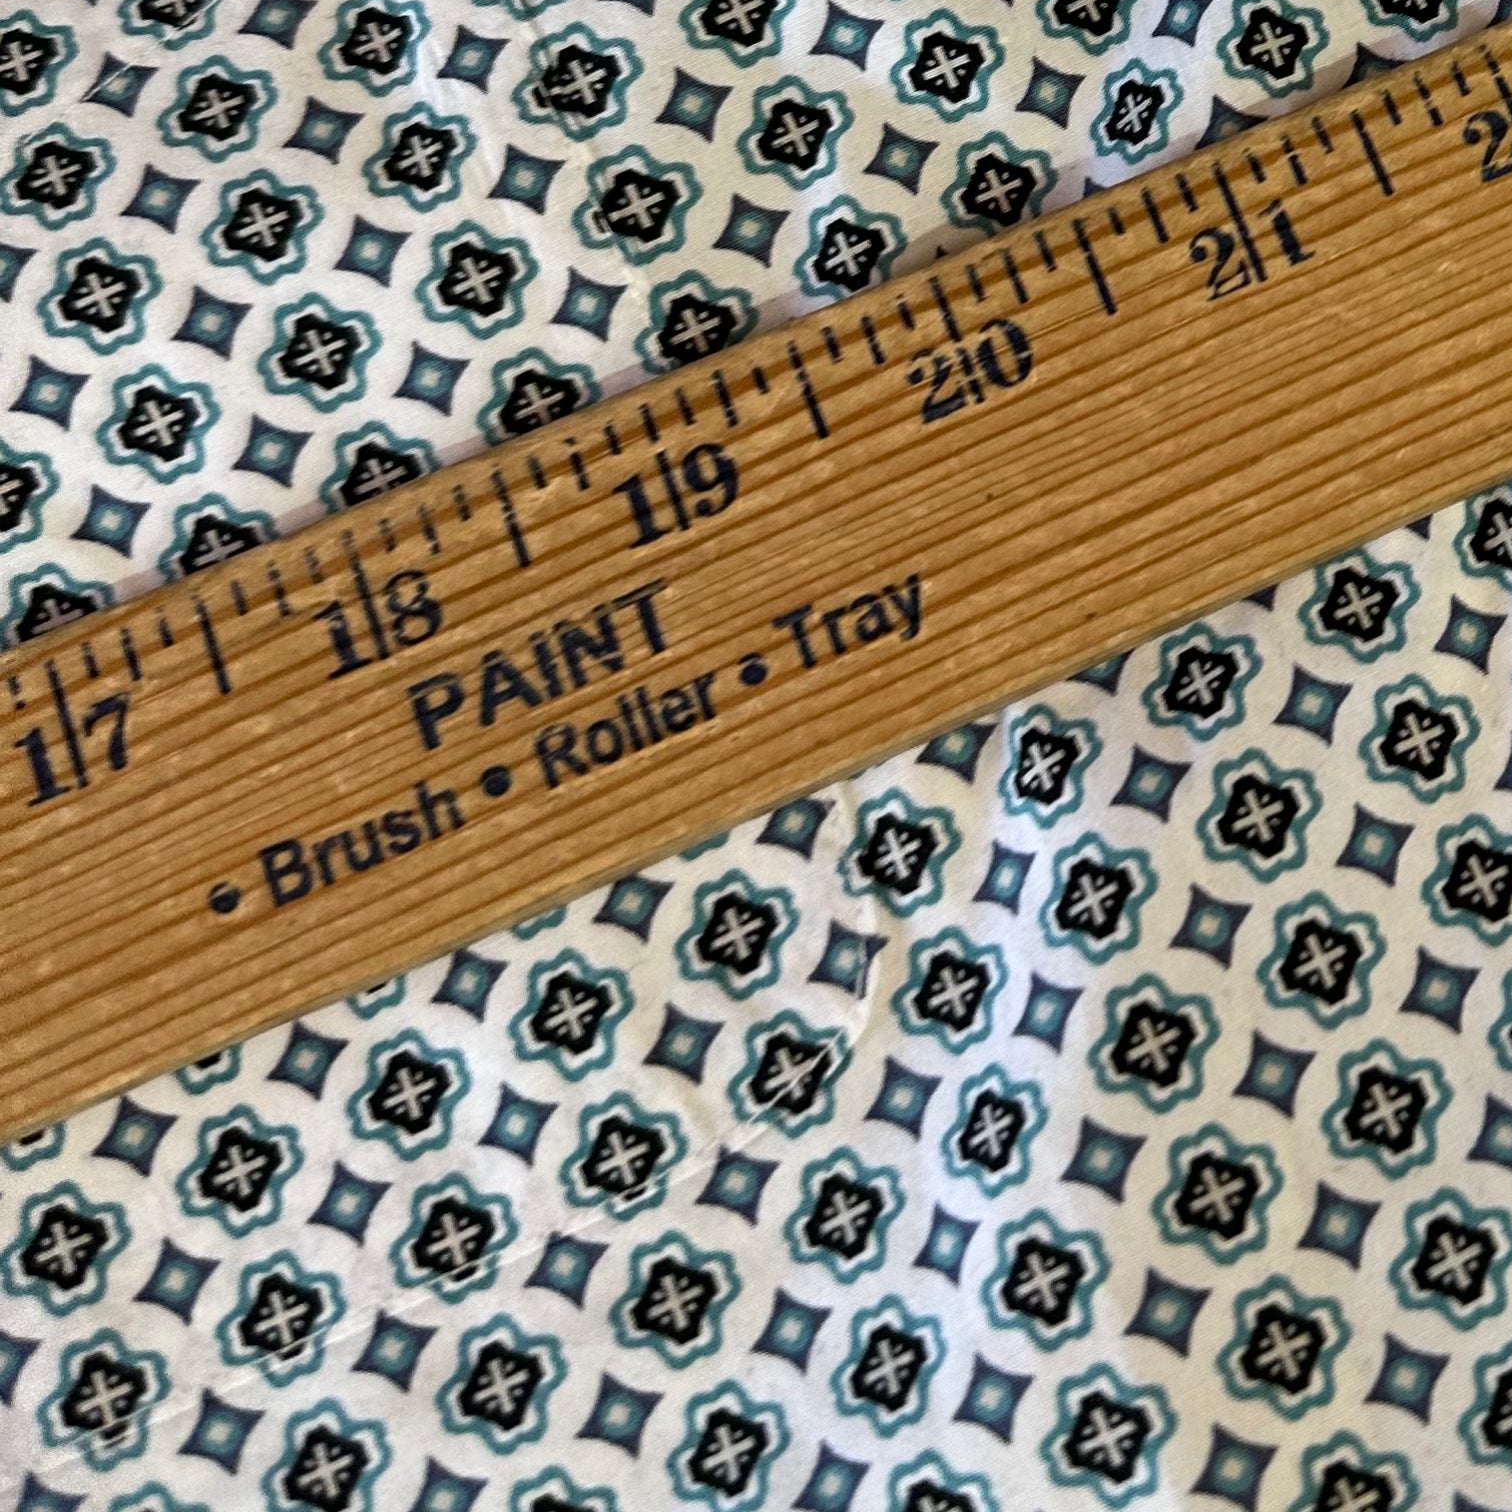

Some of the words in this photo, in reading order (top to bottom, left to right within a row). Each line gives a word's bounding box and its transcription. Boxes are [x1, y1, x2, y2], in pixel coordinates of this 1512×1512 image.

[1190, 199, 1316, 301] 21
[905, 317, 1034, 423] 20
[612, 442, 739, 551] 19
[313, 569, 444, 679] 18
[407, 577, 673, 751] PAINT
[14, 694, 132, 806] 17
[259, 778, 466, 907] Brush
[534, 667, 718, 788] Roller
[775, 572, 925, 670] Tray
